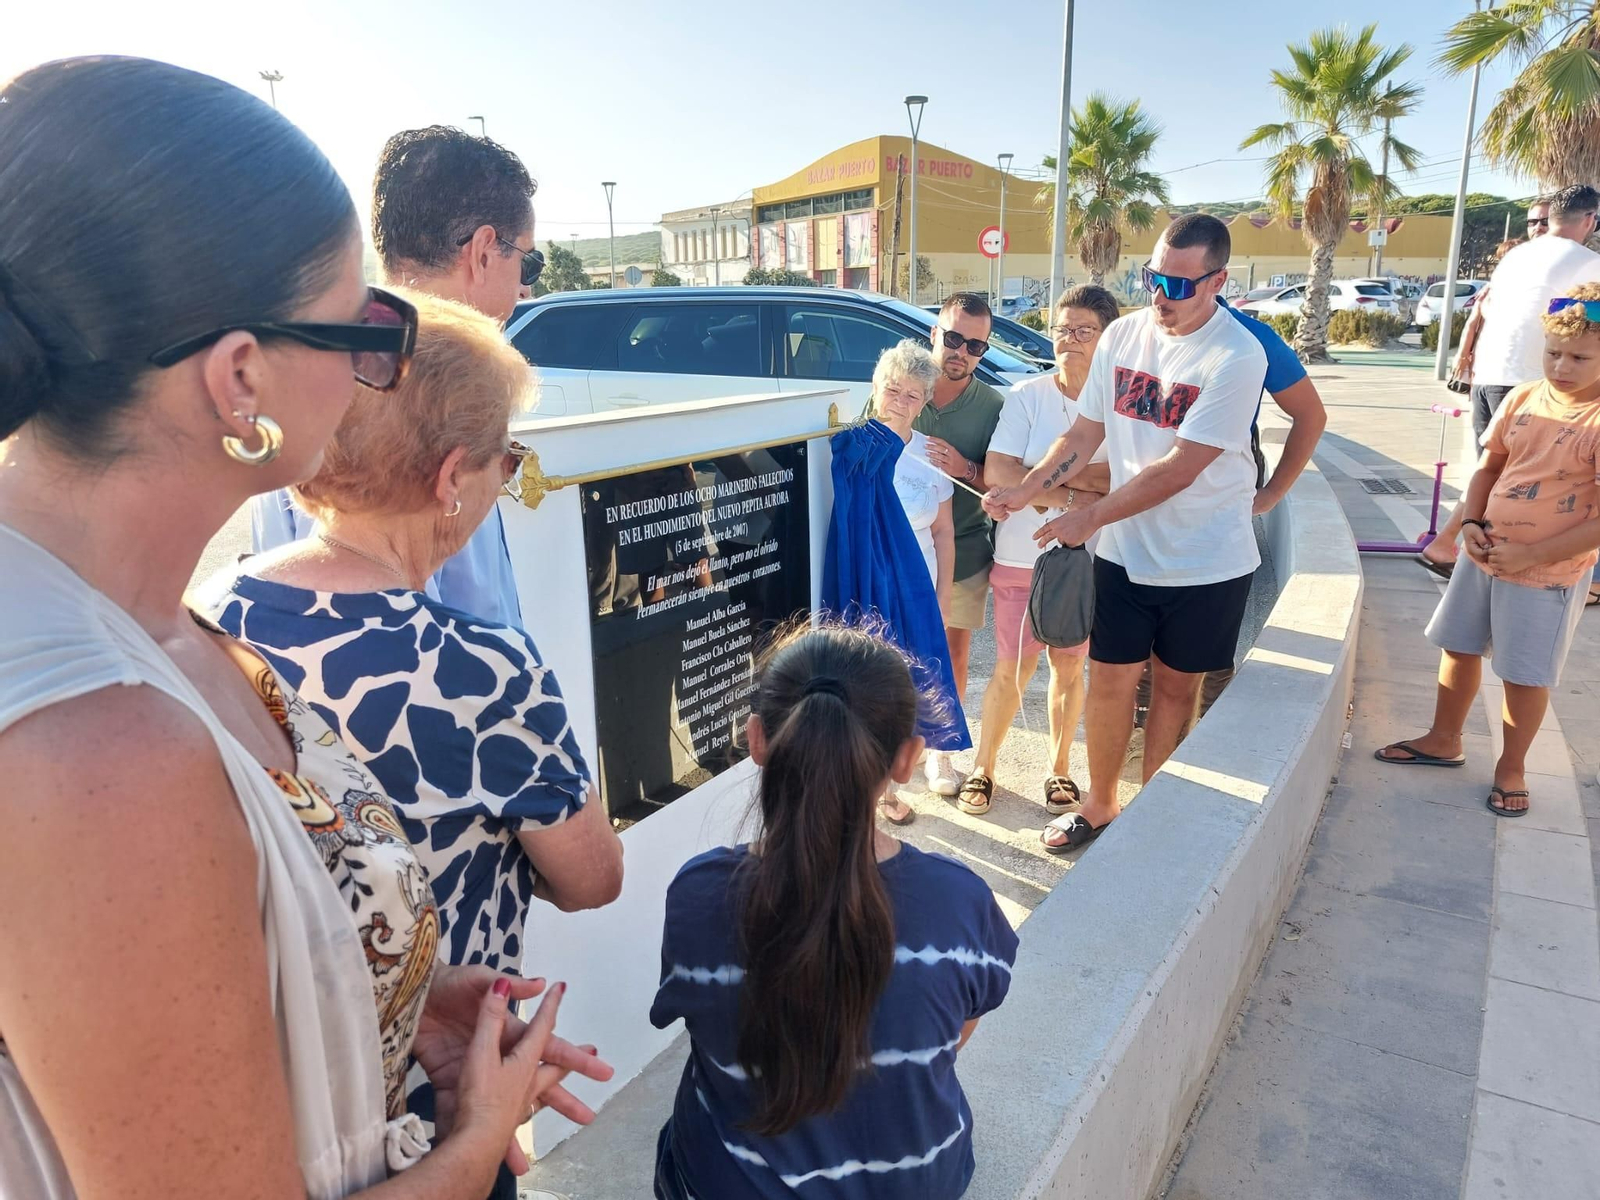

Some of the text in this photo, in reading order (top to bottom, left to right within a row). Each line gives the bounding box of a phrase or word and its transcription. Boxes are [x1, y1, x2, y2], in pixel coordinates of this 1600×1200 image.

[806, 158, 875, 185] BAZAR PUERTO
[930, 160, 973, 179] PUERTO
[606, 467, 794, 524] EN RECUERDO DE LOS OCHO MARINEROS FALLECIDOS
[619, 490, 789, 546] EN EL HUNDIMIENTO DEL NUEVO PEPITA AURORA
[675, 523, 749, 556] (5 de septiembre de 2007)
[647, 540, 778, 592] El mar nos dejó el llanto, pero no el olvido
[637, 564, 781, 620] Permanecerán siempre en nuestros corazones.
[686, 601, 746, 632] Manuel Alba García
[682, 617, 750, 652] Manuel Buela Sánchez
[681, 634, 752, 671] Francisco Cla Caballero
[682, 669, 706, 689] Manuel
[710, 656, 735, 677] Corrales
[675, 691, 699, 713] Manuel
[700, 677, 730, 700] Fernández
[702, 696, 723, 716] Miguel
[725, 690, 734, 705] Gil
[735, 681, 760, 700] Guerrero
[687, 724, 709, 745] Andrés
[711, 714, 727, 732] Lucio
[712, 731, 729, 749] Reyes
